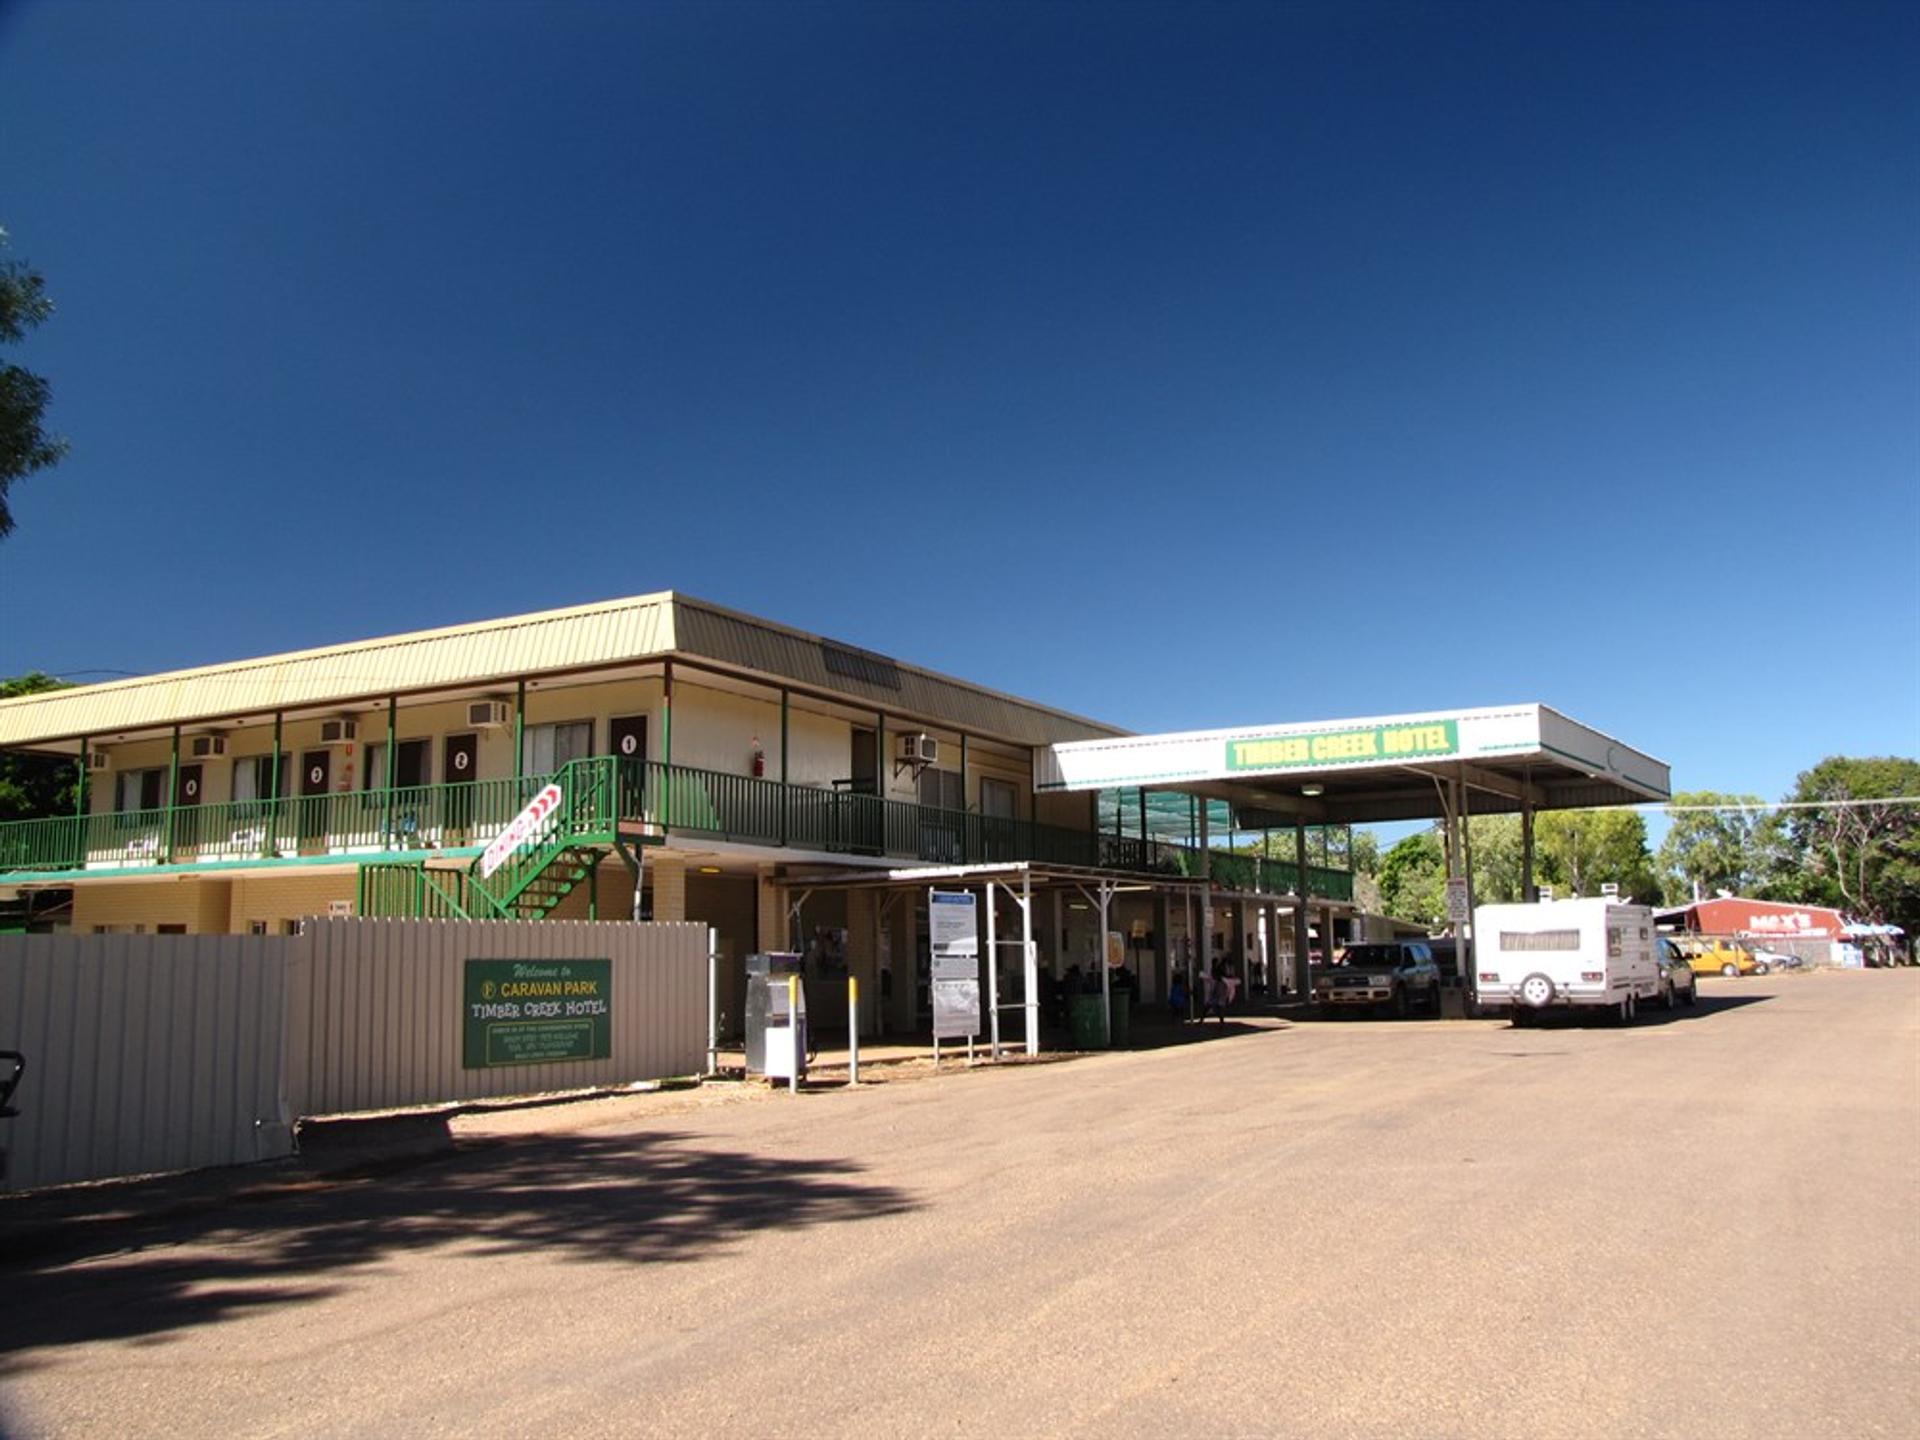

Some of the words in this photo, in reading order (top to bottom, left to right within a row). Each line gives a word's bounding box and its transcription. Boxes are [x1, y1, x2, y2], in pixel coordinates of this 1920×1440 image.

[513, 963, 558, 977] Welcome
[560, 965, 571, 976] to
[501, 982, 562, 997] CARAVAN
[564, 980, 597, 995] PARK
[471, 1002, 521, 1019] TIMBER
[523, 1001, 562, 1017] CREEK
[565, 999, 606, 1016] HOTEL
